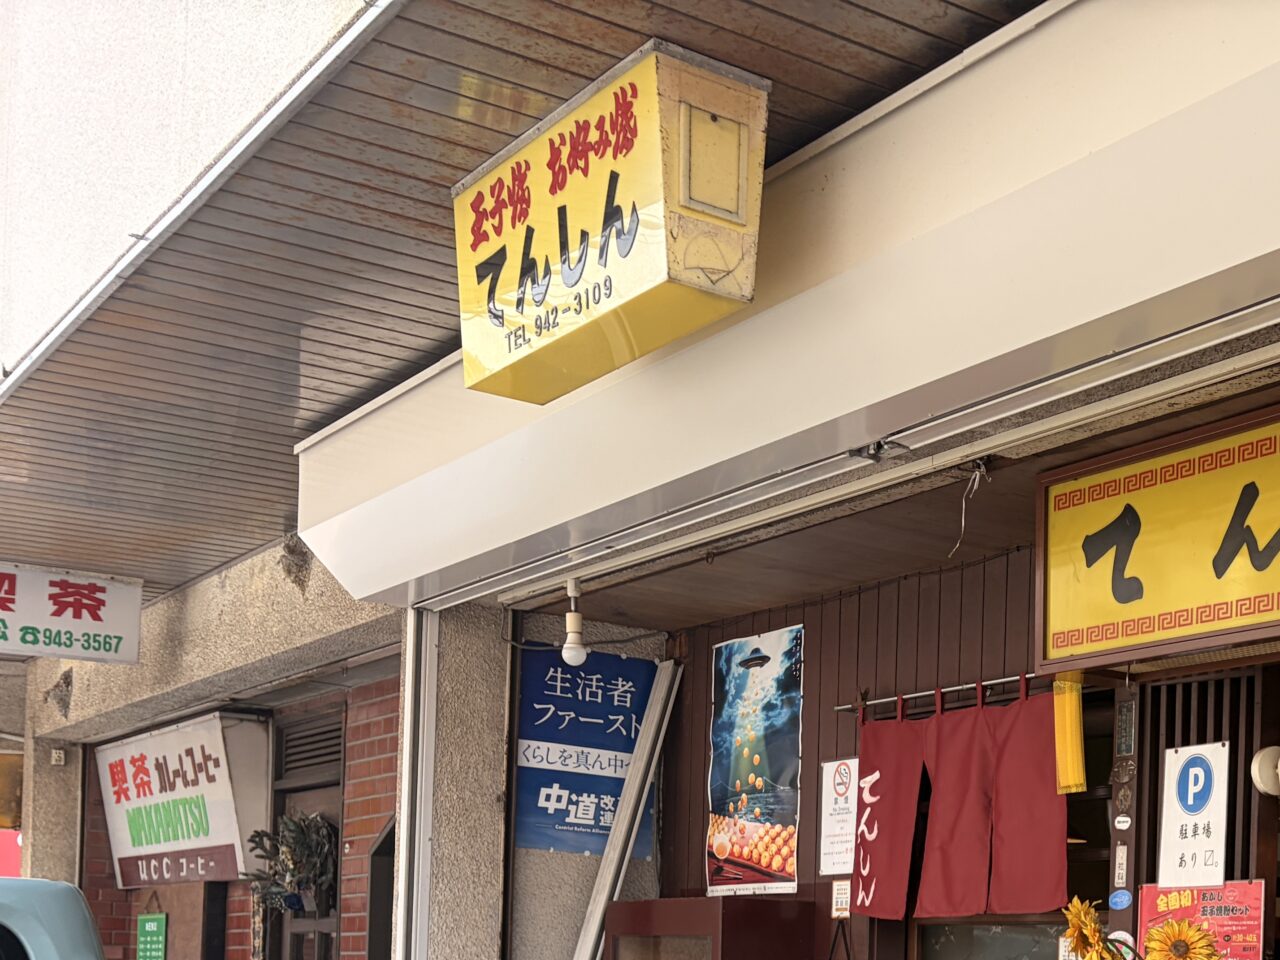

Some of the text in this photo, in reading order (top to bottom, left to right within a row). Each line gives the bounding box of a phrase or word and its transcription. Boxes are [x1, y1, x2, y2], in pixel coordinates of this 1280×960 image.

[475, 170, 640, 328] てんしん
[505, 276, 613, 353] TEL 942-3109
[43, 628, 123, 654] 943-3567
[544, 667, 636, 708] 生活者
[533, 703, 641, 740] ファースト
[108, 752, 154, 804] 喫茶
[1187, 766, 1205, 806] P
[126, 794, 209, 848] WAKAMATSU
[538, 783, 598, 826] 中道
[857, 770, 880, 907] てんしん
[1178, 821, 1212, 840] 駐車場
[138, 855, 215, 881] UCC コーヒー
